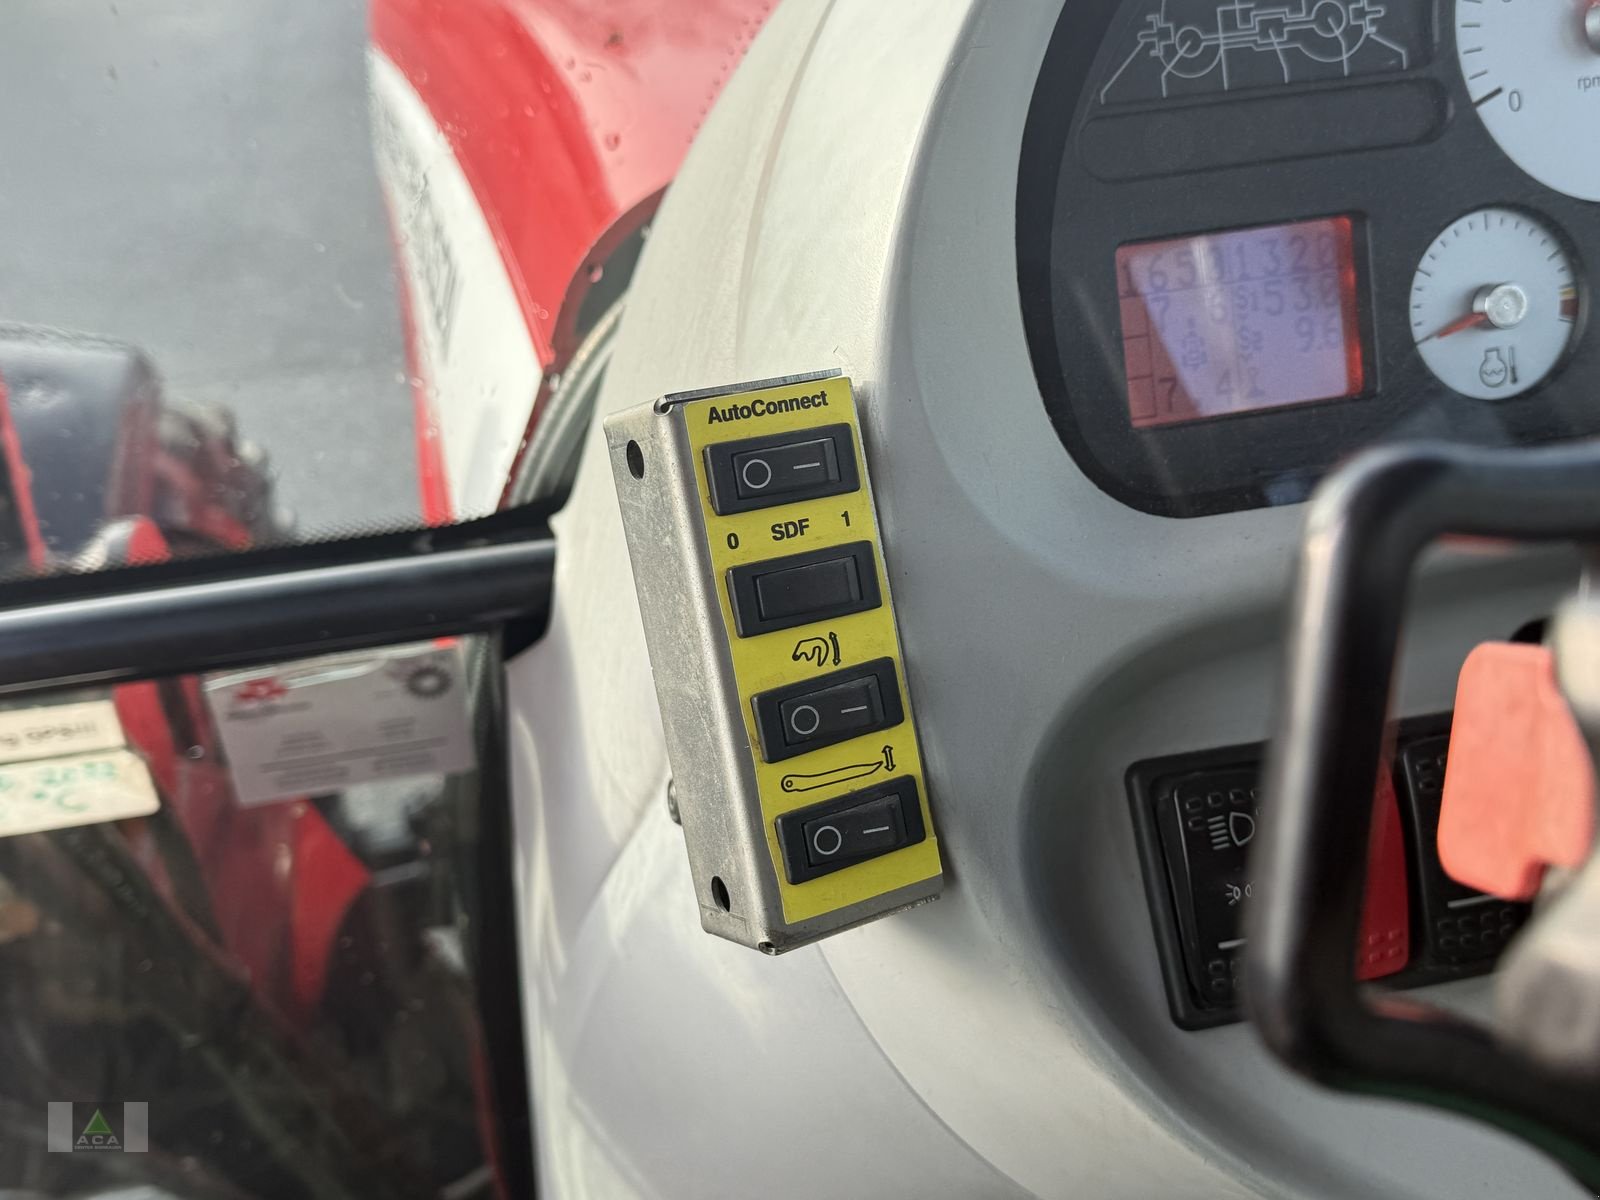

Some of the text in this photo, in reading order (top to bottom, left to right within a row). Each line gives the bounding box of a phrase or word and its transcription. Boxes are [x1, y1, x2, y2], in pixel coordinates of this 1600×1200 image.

[1508, 90, 1522, 112] 0
[708, 391, 828, 424] AutoConnect
[1159, 377, 1177, 412] 7
[727, 511, 851, 549] 0 SDF 1
